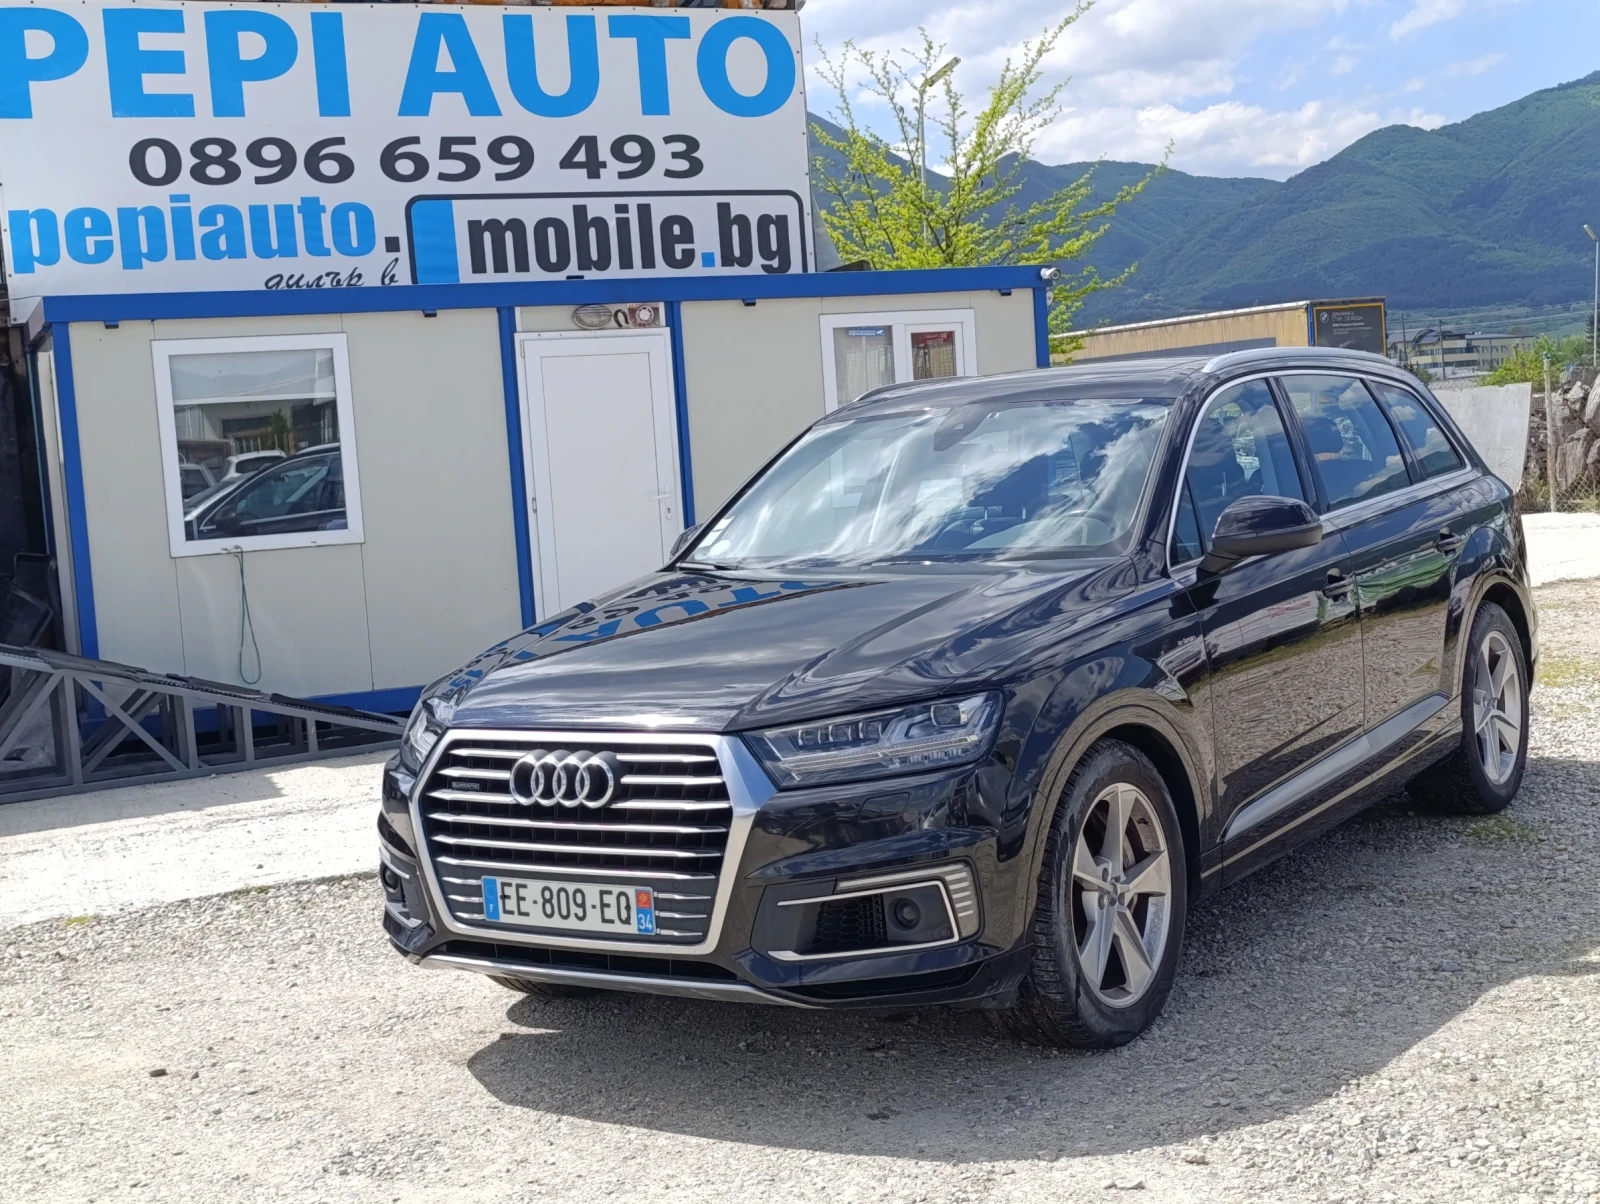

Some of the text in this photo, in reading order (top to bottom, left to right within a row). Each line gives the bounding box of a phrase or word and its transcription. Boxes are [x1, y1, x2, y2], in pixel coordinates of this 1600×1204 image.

[0, 8, 796, 118] PEPI AUTO
[129, 134, 704, 187] 0896 659 493
[467, 202, 792, 275] mobile.bg
[489, 904, 494, 913] F
[500, 881, 632, 926] EE-809-EQ
[638, 914, 653, 930] 34
